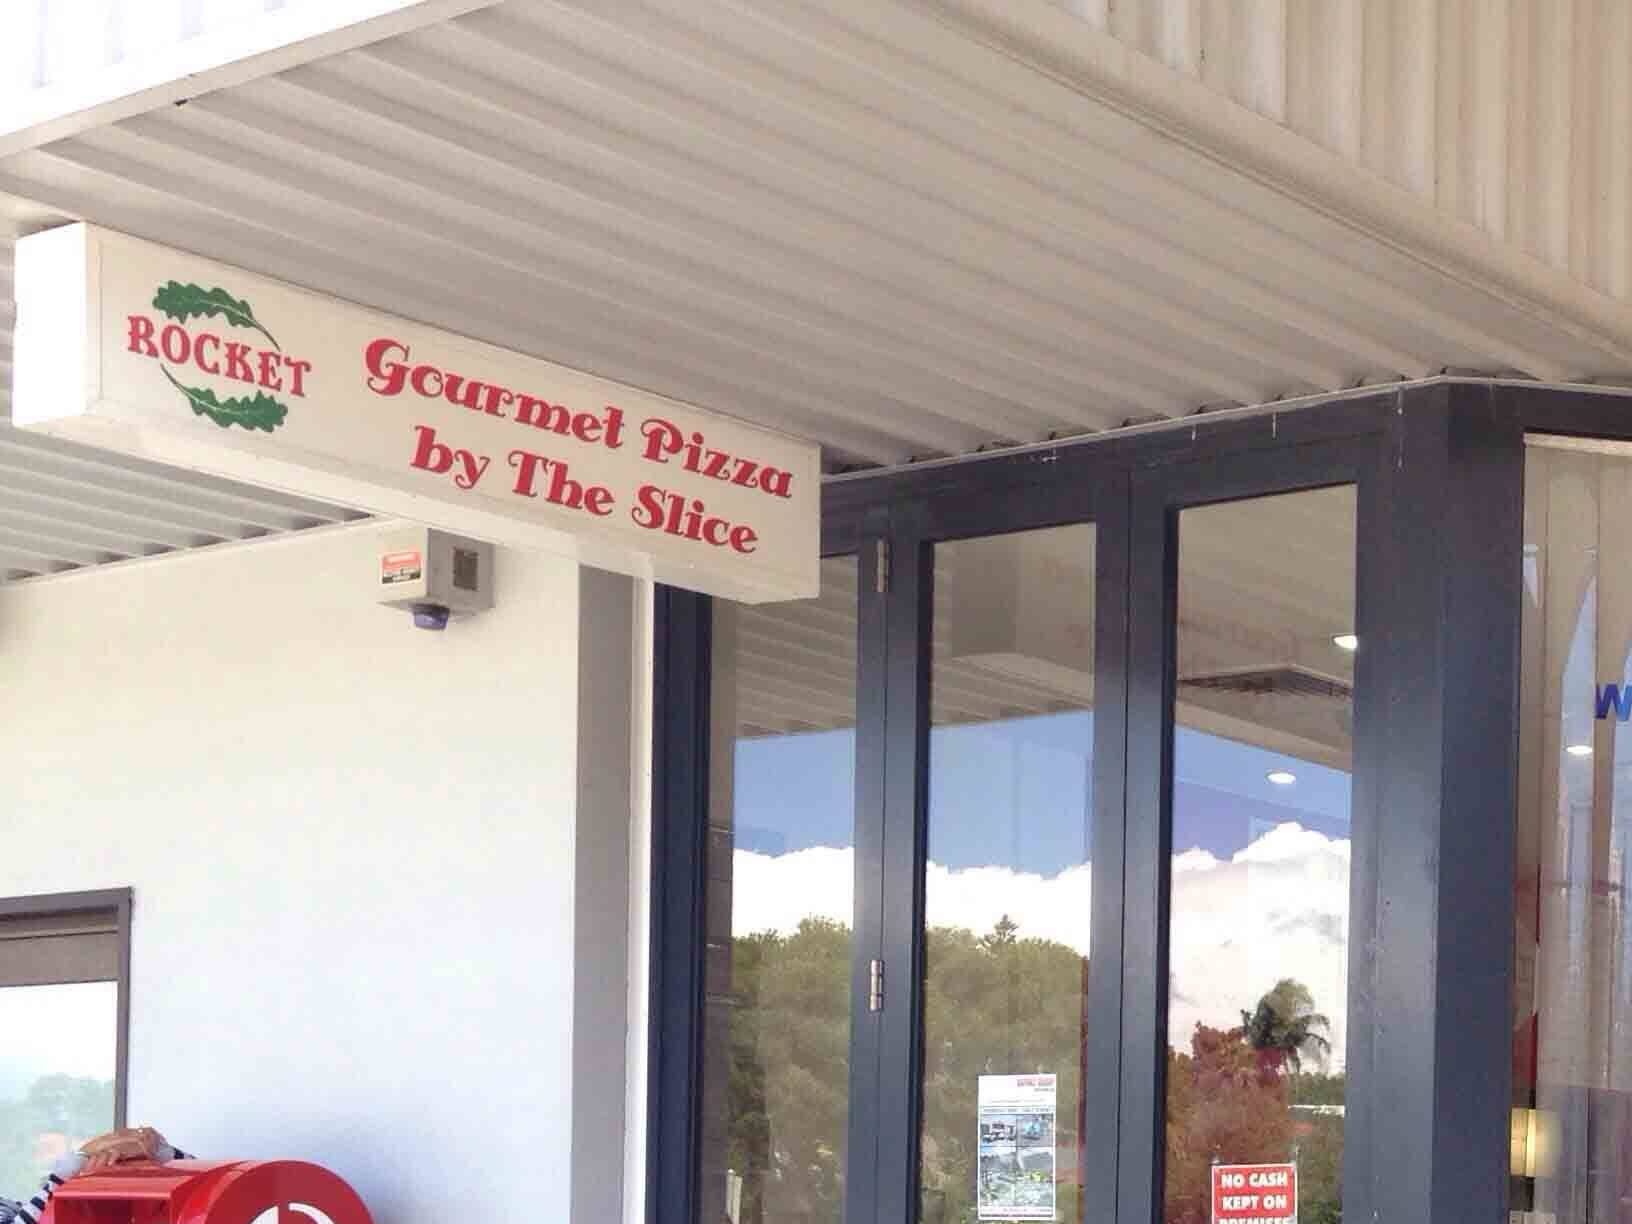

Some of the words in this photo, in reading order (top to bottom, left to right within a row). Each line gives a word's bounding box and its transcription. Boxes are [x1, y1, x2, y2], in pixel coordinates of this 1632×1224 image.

[127, 315, 312, 399] ROCKET
[365, 338, 625, 449] Gourmet
[641, 419, 794, 499] Pizza
[410, 426, 490, 490] by
[508, 450, 614, 516] The
[630, 485, 759, 555] Slice
[1221, 1173, 1245, 1188] NO
[1249, 1172, 1289, 1187] CASH
[1222, 1195, 1260, 1211] KEPT
[1263, 1194, 1287, 1209] ON
